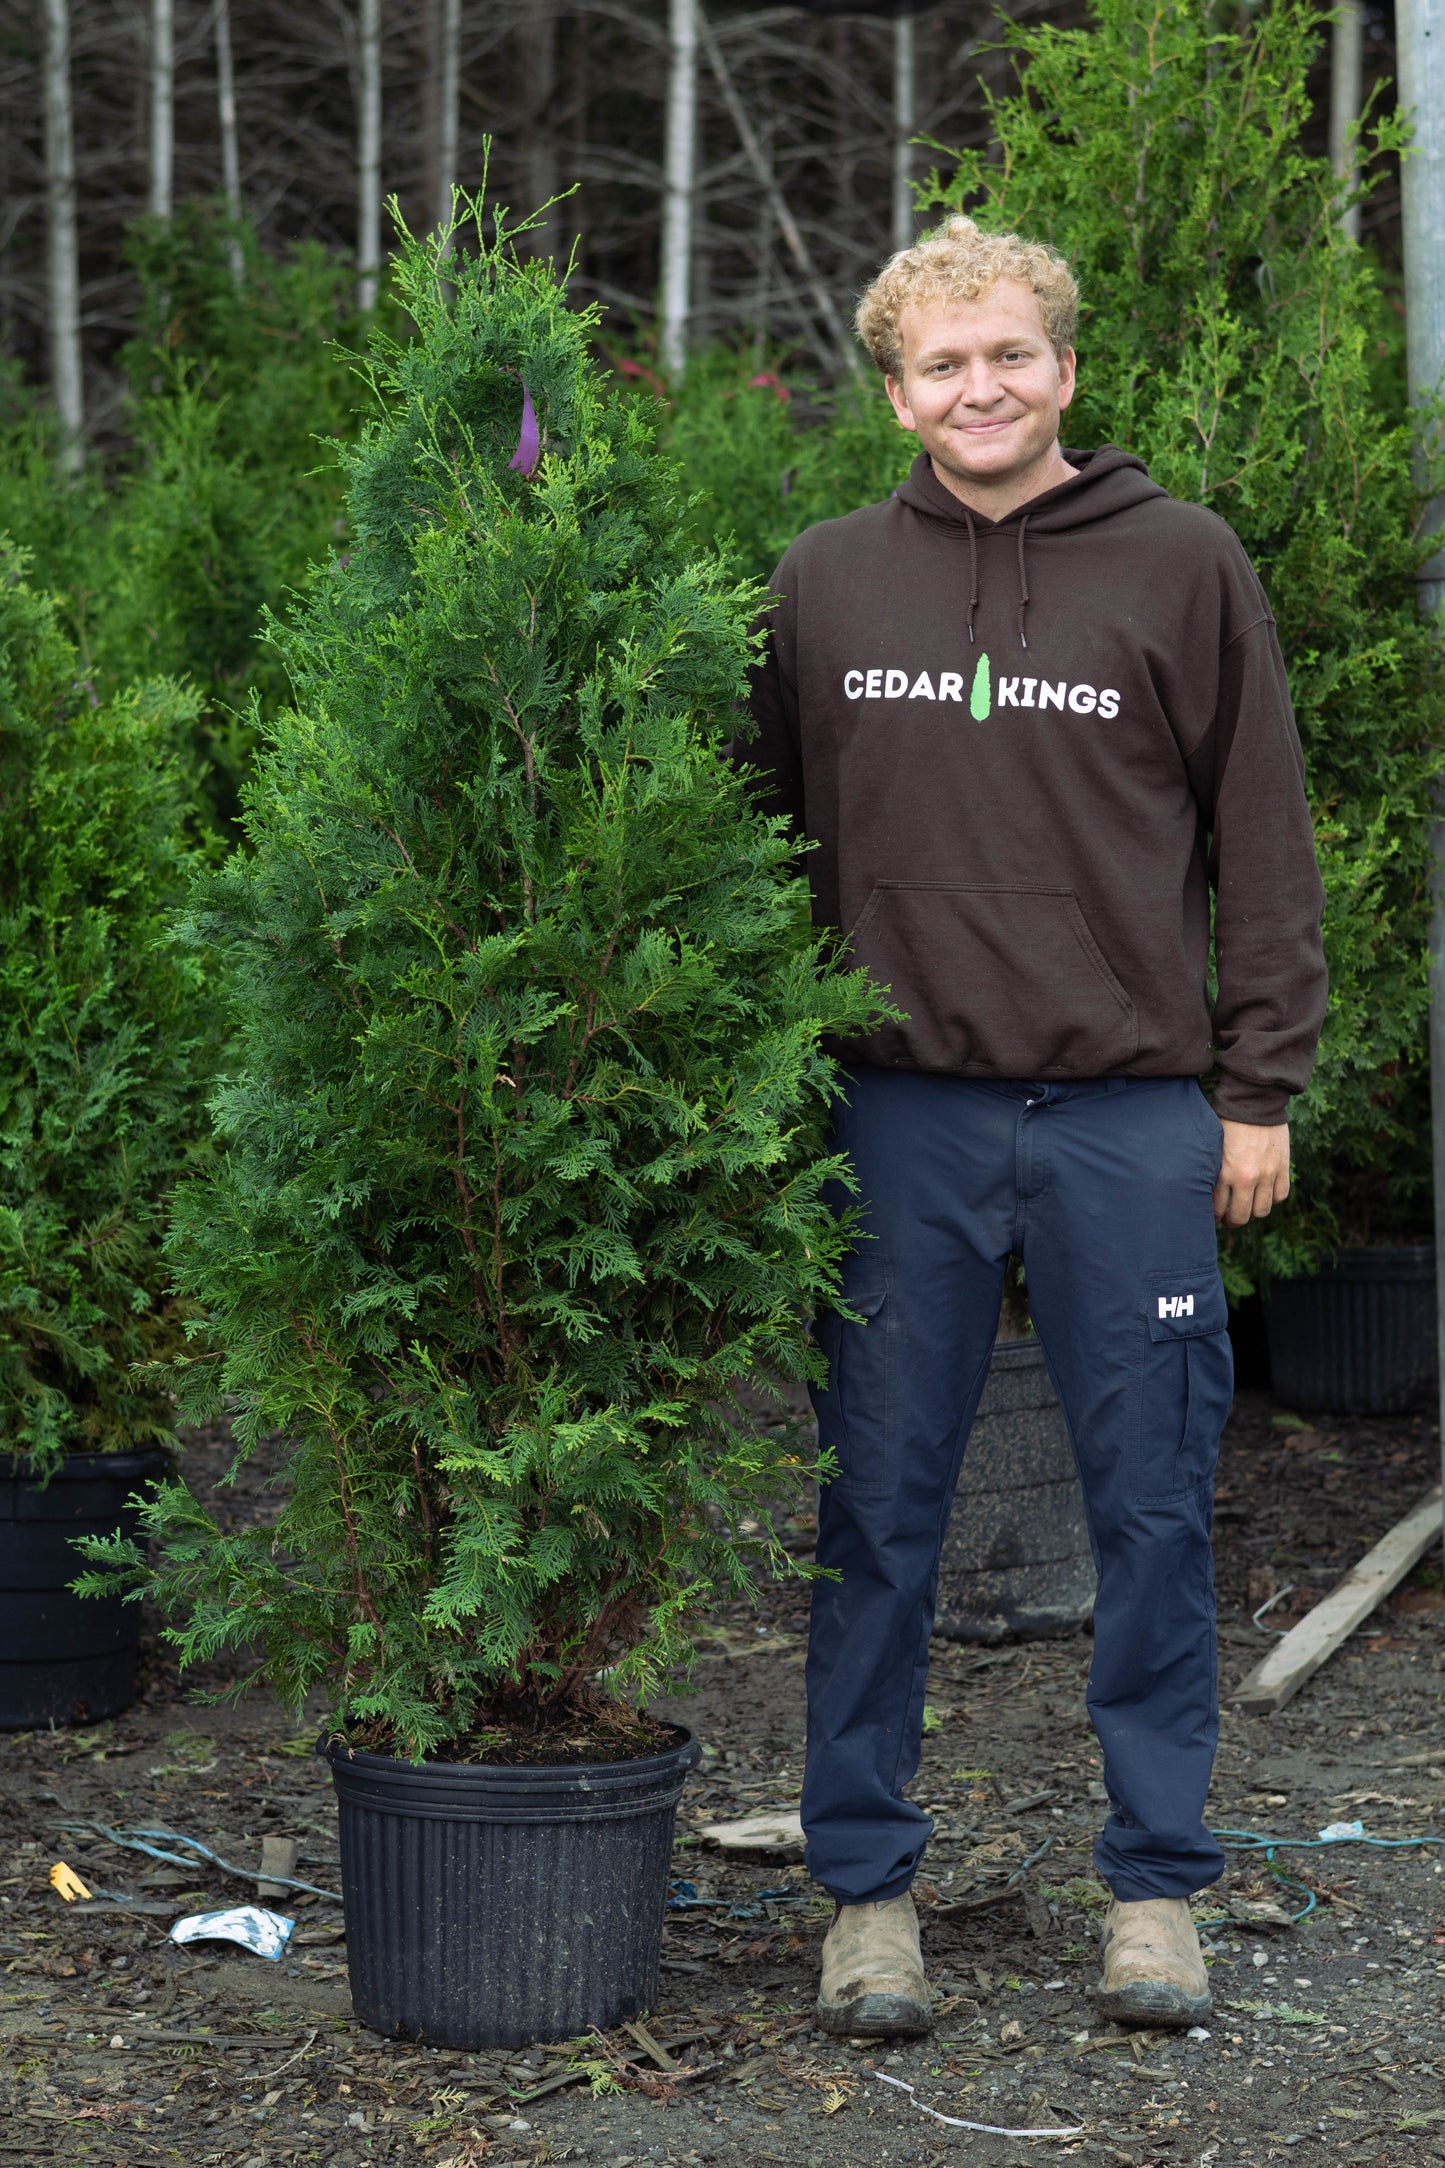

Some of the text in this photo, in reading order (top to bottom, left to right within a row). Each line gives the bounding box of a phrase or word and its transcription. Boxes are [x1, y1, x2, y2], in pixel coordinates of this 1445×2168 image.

[844, 669, 1121, 719] CEDAR KINGS
[1158, 1295, 1194, 1319] HH
